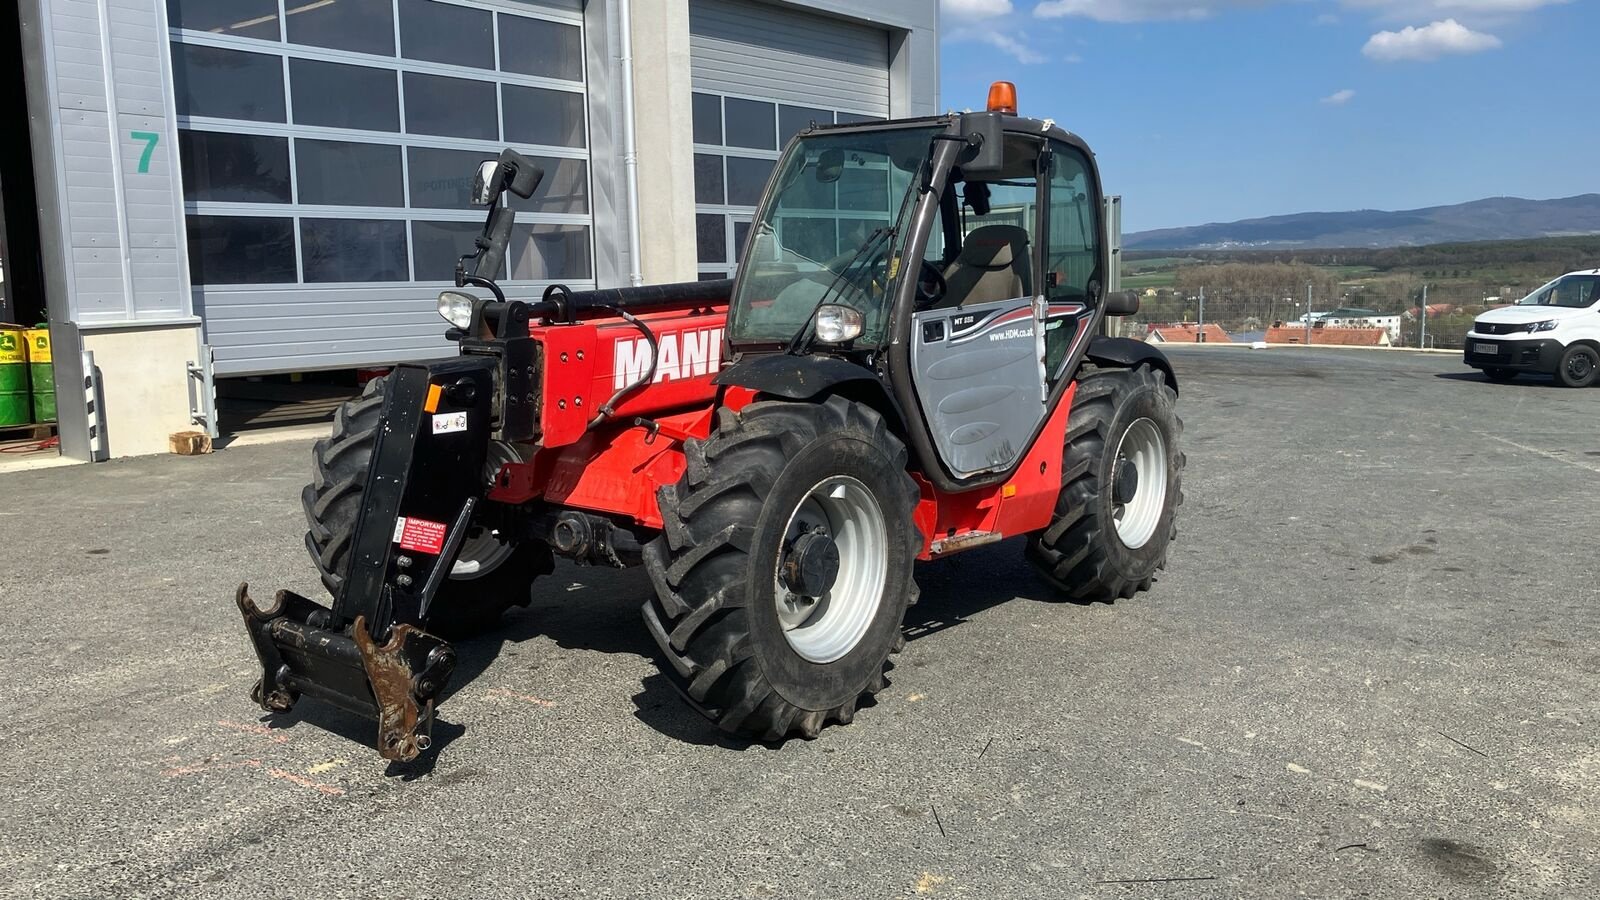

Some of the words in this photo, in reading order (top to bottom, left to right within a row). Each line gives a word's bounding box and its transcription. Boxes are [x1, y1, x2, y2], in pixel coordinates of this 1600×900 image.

[131, 131, 159, 173] 7
[615, 329, 725, 389] MANI
[407, 519, 445, 529] IMPORTANT
